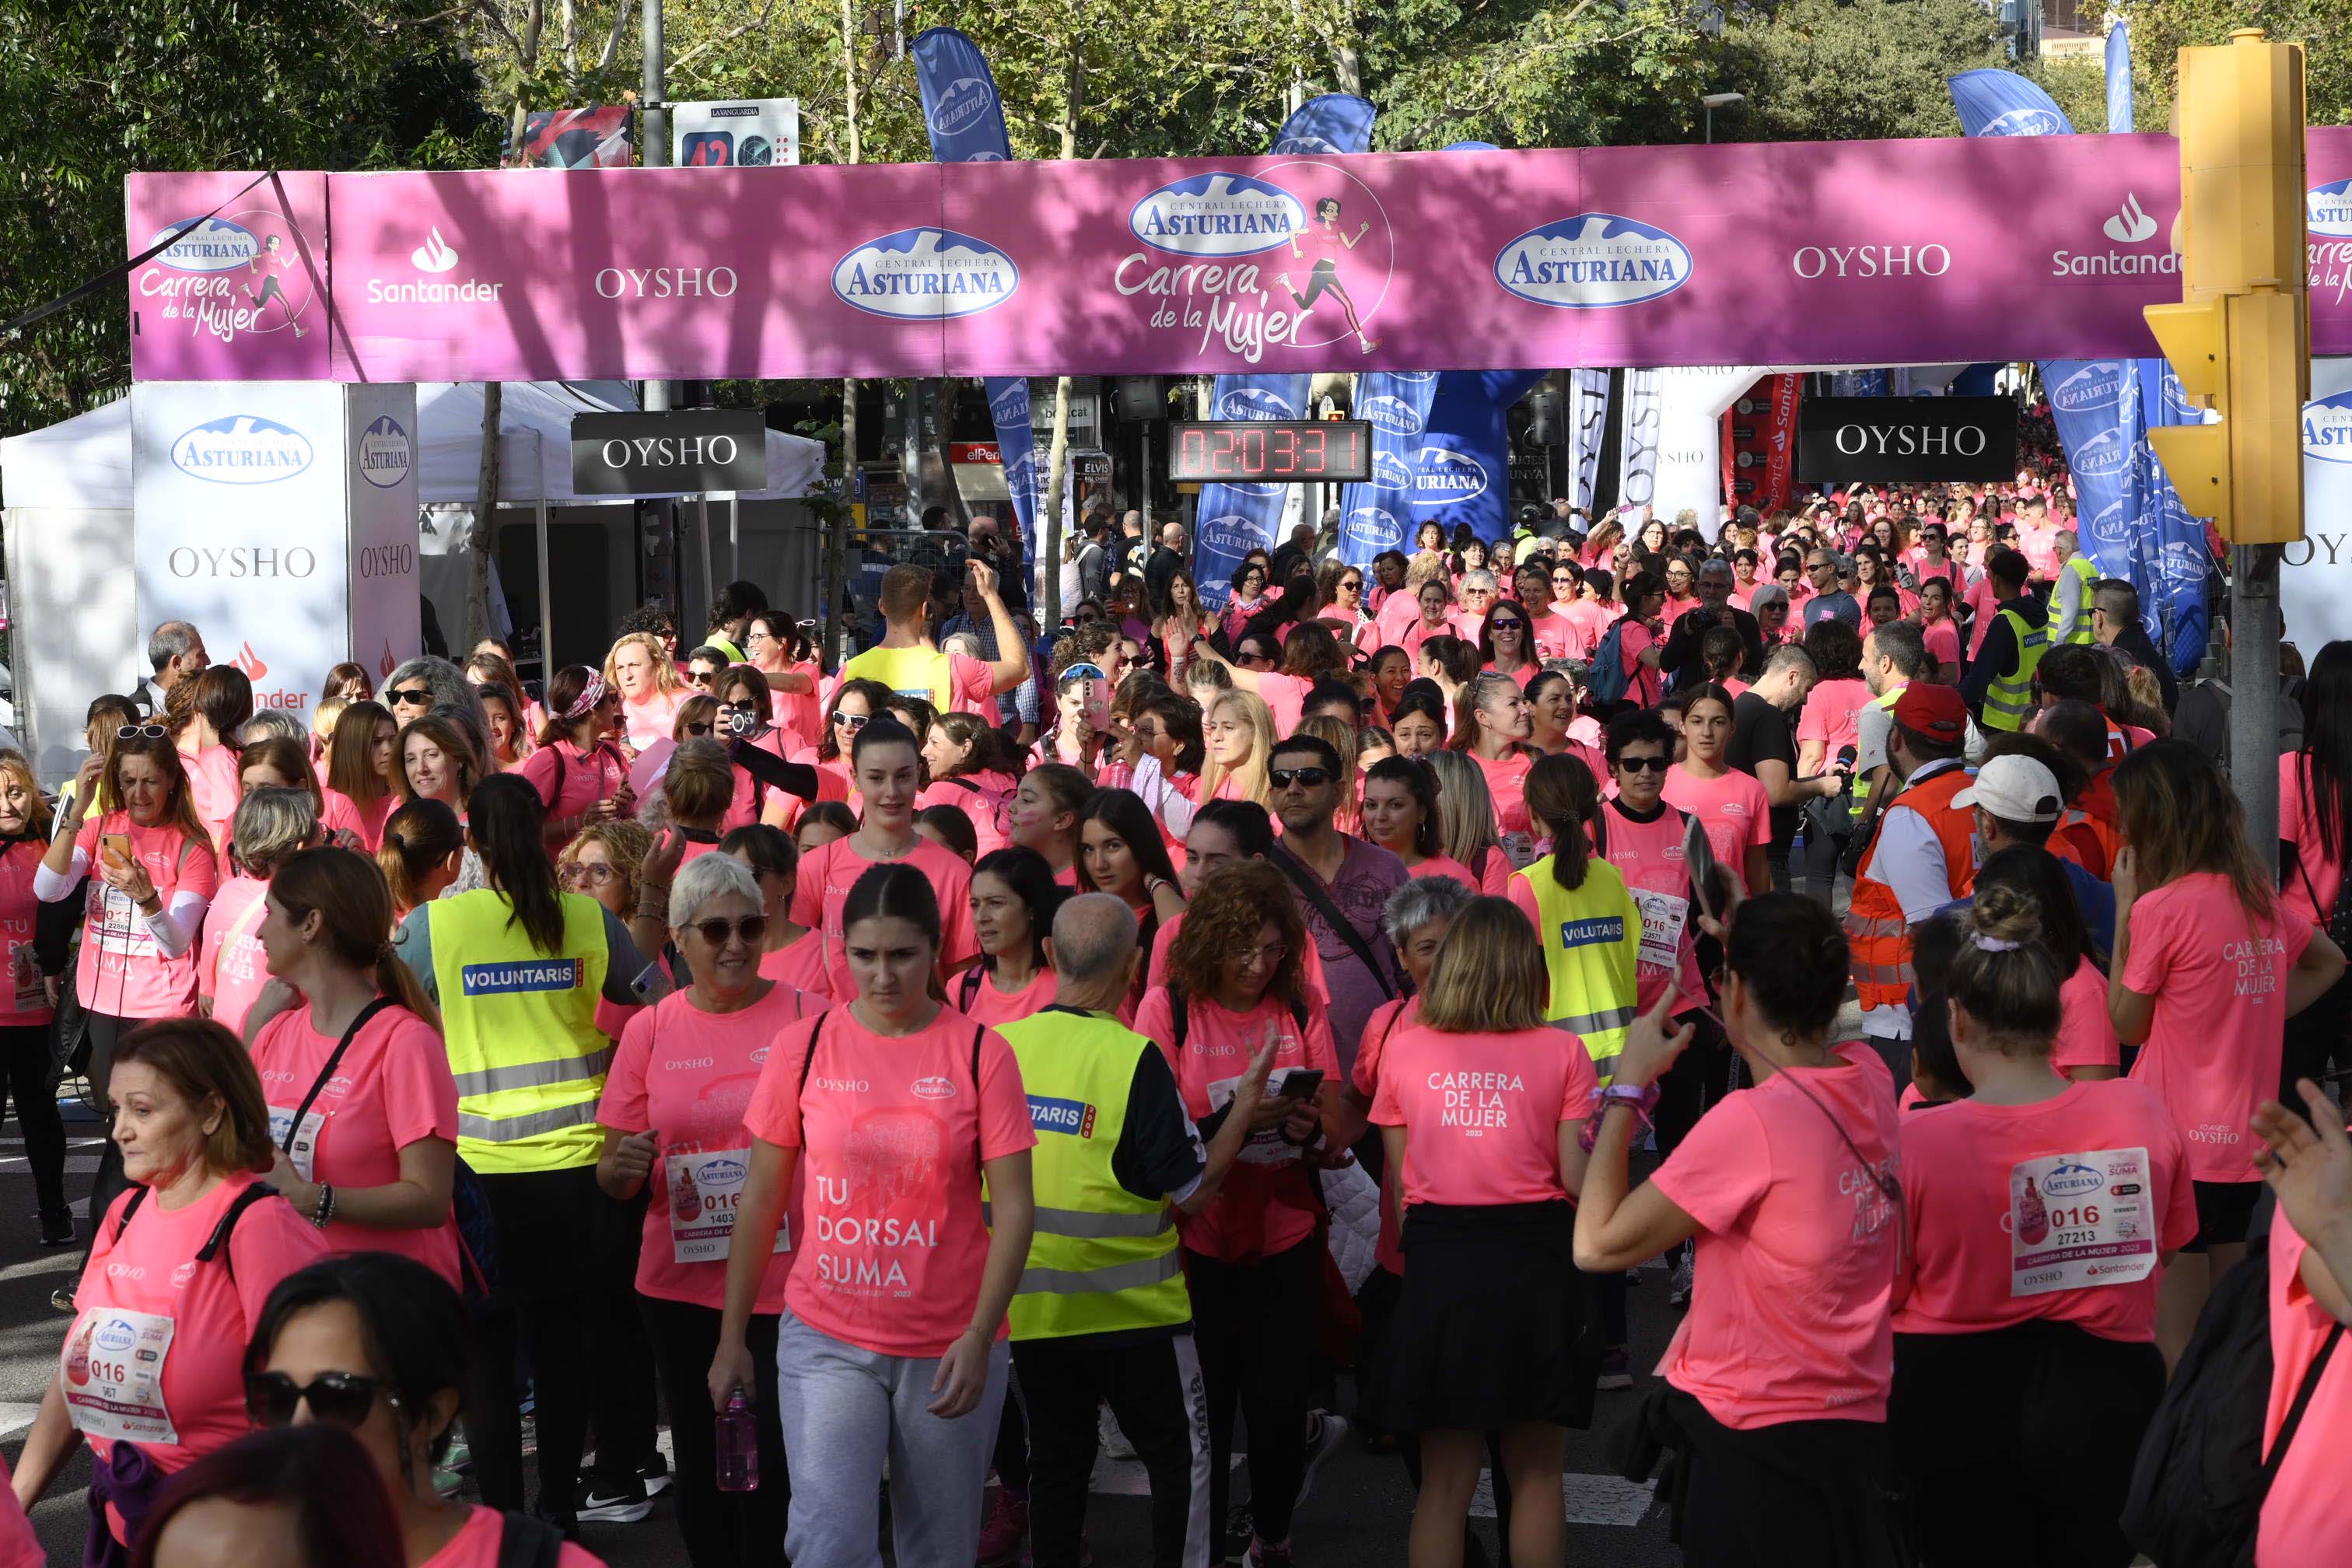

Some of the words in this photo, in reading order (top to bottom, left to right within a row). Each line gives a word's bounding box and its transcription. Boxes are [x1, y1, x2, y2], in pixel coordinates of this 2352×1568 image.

[720, 107, 758, 116] VANGUARDIA
[1171, 201, 1226, 210] CENTRAL
[1231, 200, 1287, 209] LECHERA
[1143, 205, 1293, 236] ASTURIANA
[1540, 247, 1601, 257] CENTRAL
[1608, 245, 1670, 255] LECHERA
[1793, 243, 1951, 278] OYSHO
[875, 259, 933, 268] CENTRAL
[940, 258, 998, 268] LECHERA
[1509, 250, 1678, 285] ASTURIANA
[2053, 250, 2182, 277] Santand
[139, 268, 230, 298] Carrera
[595, 267, 738, 299] OYSHO
[845, 262, 1006, 296] ASTURIANA
[1115, 253, 1260, 296] Carrera
[367, 279, 504, 303] Santander
[162, 299, 178, 319] de
[183, 298, 194, 319] la
[193, 294, 265, 343] Mujer
[1150, 299, 1177, 328] de
[1183, 297, 1202, 328] la
[1199, 290, 1314, 363] Mujer
[1363, 405, 1416, 432] ASTURIANA
[1836, 425, 1986, 455] OYSHO
[182, 442, 303, 467] ASTURIANA
[362, 443, 408, 470] ASTURIANA
[603, 436, 737, 467] OYSHO
[967, 449, 1003, 460] elPeri
[1182, 430, 1355, 473] 02:03:31
[1084, 464, 1108, 474] ELVIS
[1417, 475, 1480, 490] URIANA
[1346, 523, 1397, 541] ASTURIANA
[169, 547, 316, 578] OYSHO
[360, 544, 412, 578] OYSHO
[4, 919, 28, 933] TU
[1643, 919, 1665, 931] 016
[1643, 931, 1661, 940] 23571
[93, 950, 133, 974] UMA
[465, 967, 572, 989] VOLUNTARIS
[2234, 976, 2276, 996] MUJER
[665, 1057, 714, 1071] OYSHO
[816, 1076, 870, 1094] OYSHO
[1427, 1072, 1524, 1092] CARRERA
[1445, 1090, 1471, 1108] DE
[1479, 1090, 1504, 1108] LA
[1027, 1104, 1080, 1126] TARIS
[1441, 1108, 1508, 1128] MUJER
[2188, 1129, 2239, 1144] OYSHO
[702, 1170, 744, 1181] ASTURIANA
[2109, 1167, 2137, 1176] SUMA
[816, 1175, 848, 1205] TU
[2046, 1177, 2099, 1192] ASTURIANA
[710, 1214, 734, 1224] 1403
[2052, 1206, 2100, 1228] 016
[684, 1229, 712, 1238] CARRERA
[818, 1215, 938, 1248] DORSAL
[2057, 1230, 2096, 1245] 27213
[684, 1244, 716, 1255] OYSHO
[2027, 1253, 2061, 1265] CARRERA
[2088, 1247, 2118, 1255] MUJER
[817, 1254, 908, 1287] SUMA
[2024, 1271, 2063, 1286] OYSHO
[2099, 1262, 2146, 1275] Santander
[91, 1360, 125, 1383] 016
